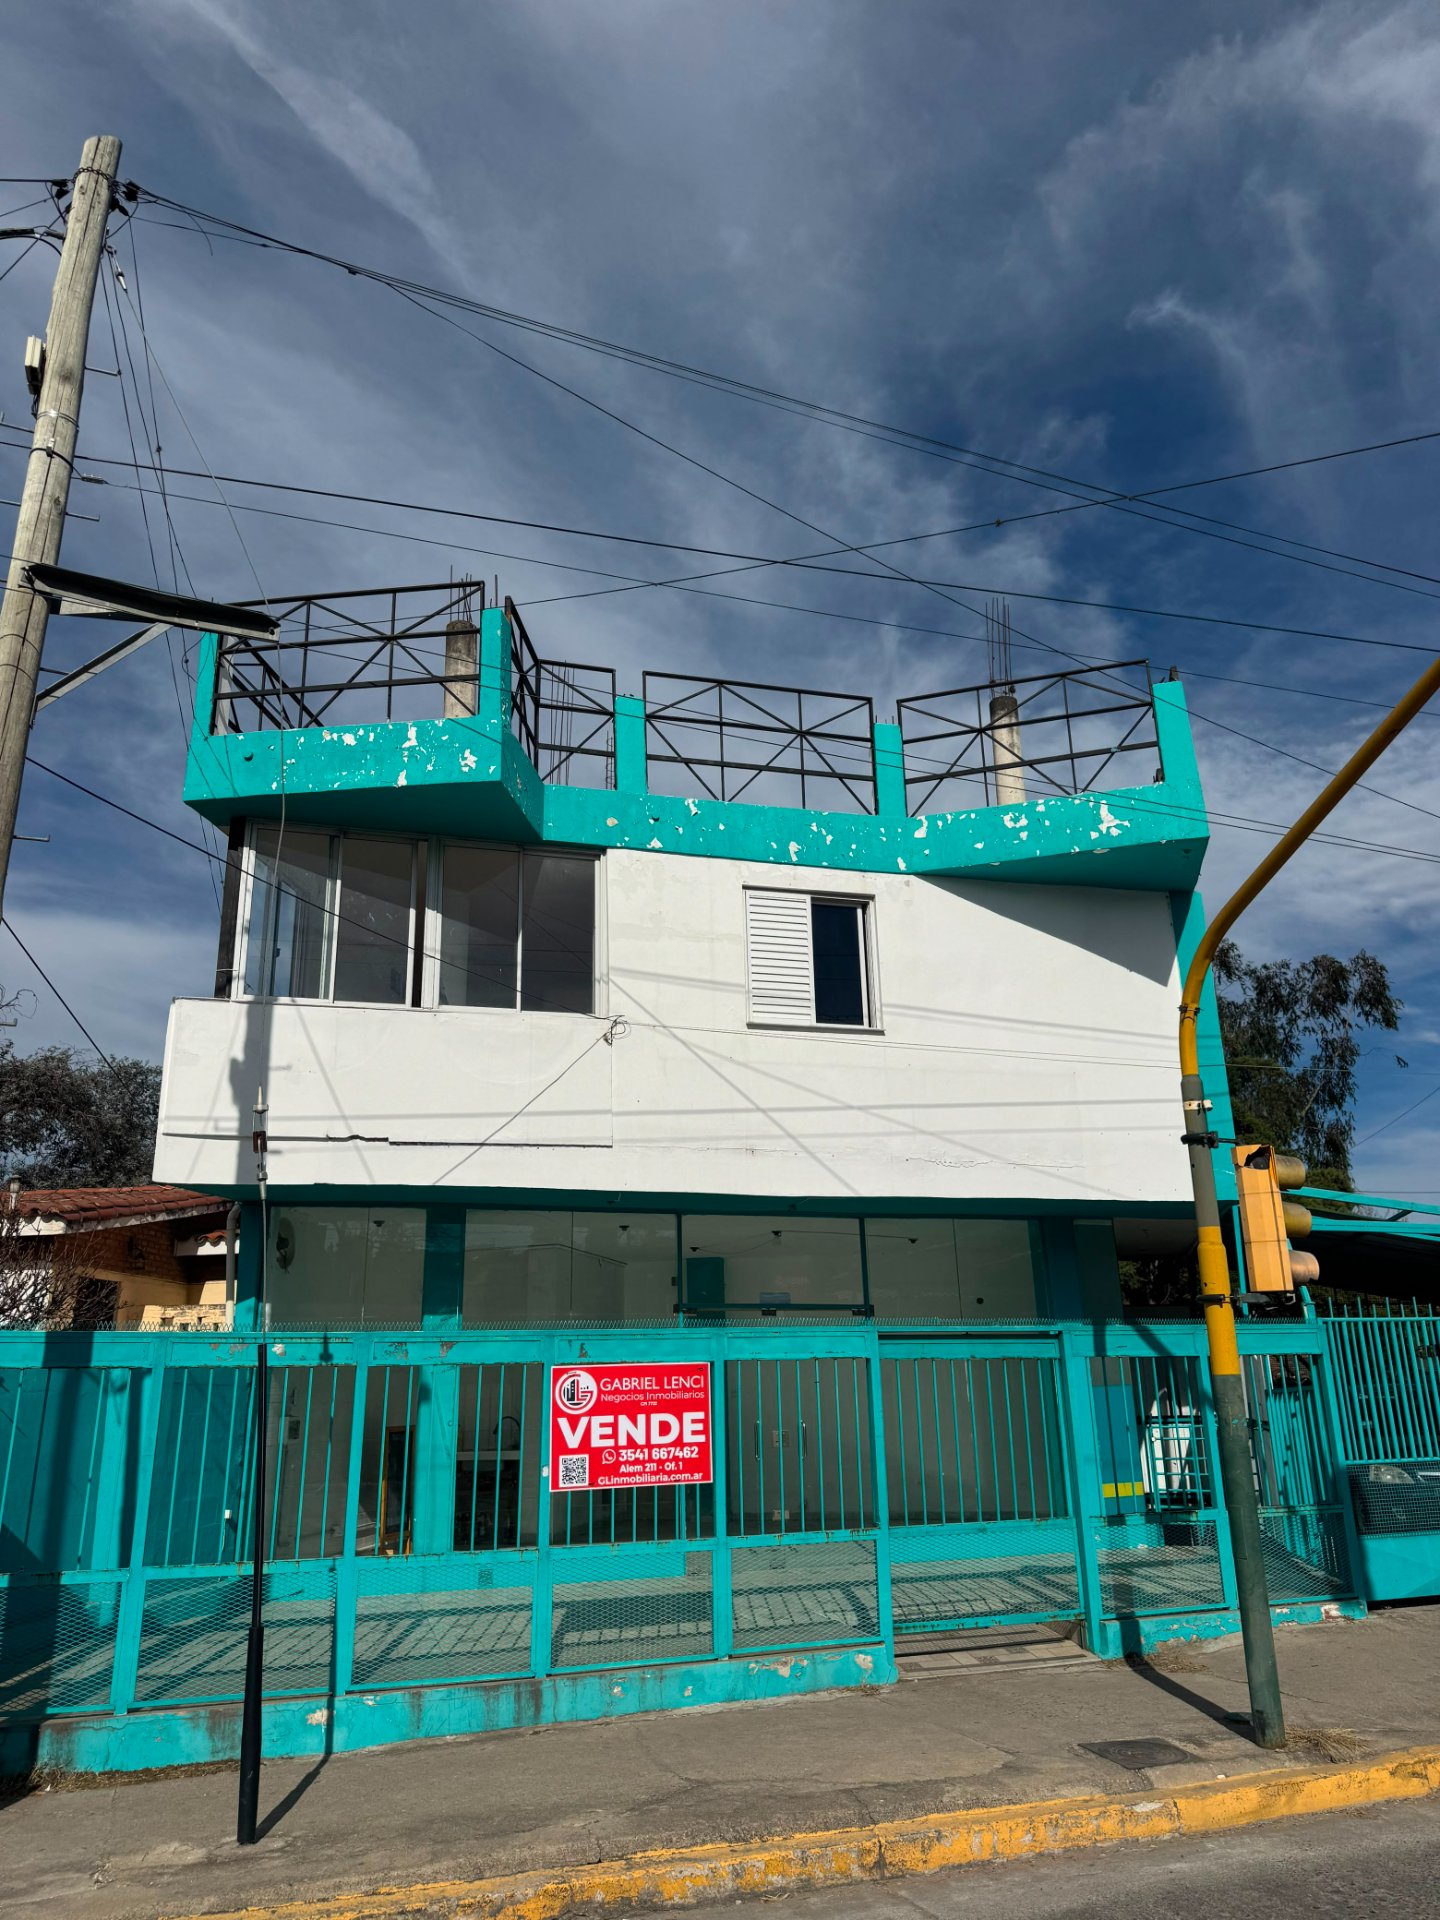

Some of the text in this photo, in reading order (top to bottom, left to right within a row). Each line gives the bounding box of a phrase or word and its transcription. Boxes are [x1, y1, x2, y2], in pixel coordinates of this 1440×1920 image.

[600, 1375, 704, 1391] GABRIEL LENCI
[601, 1390, 704, 1403] Negocios Inmobiliarios
[557, 1412, 705, 1449] VENDE
[618, 1447, 699, 1461] 3541 667462
[619, 1464, 642, 1473] Alem
[665, 1462, 677, 1471] Of.
[678, 1462, 683, 1470] 1
[598, 1472, 703, 1485] GLinmobiliaria.com.ar
